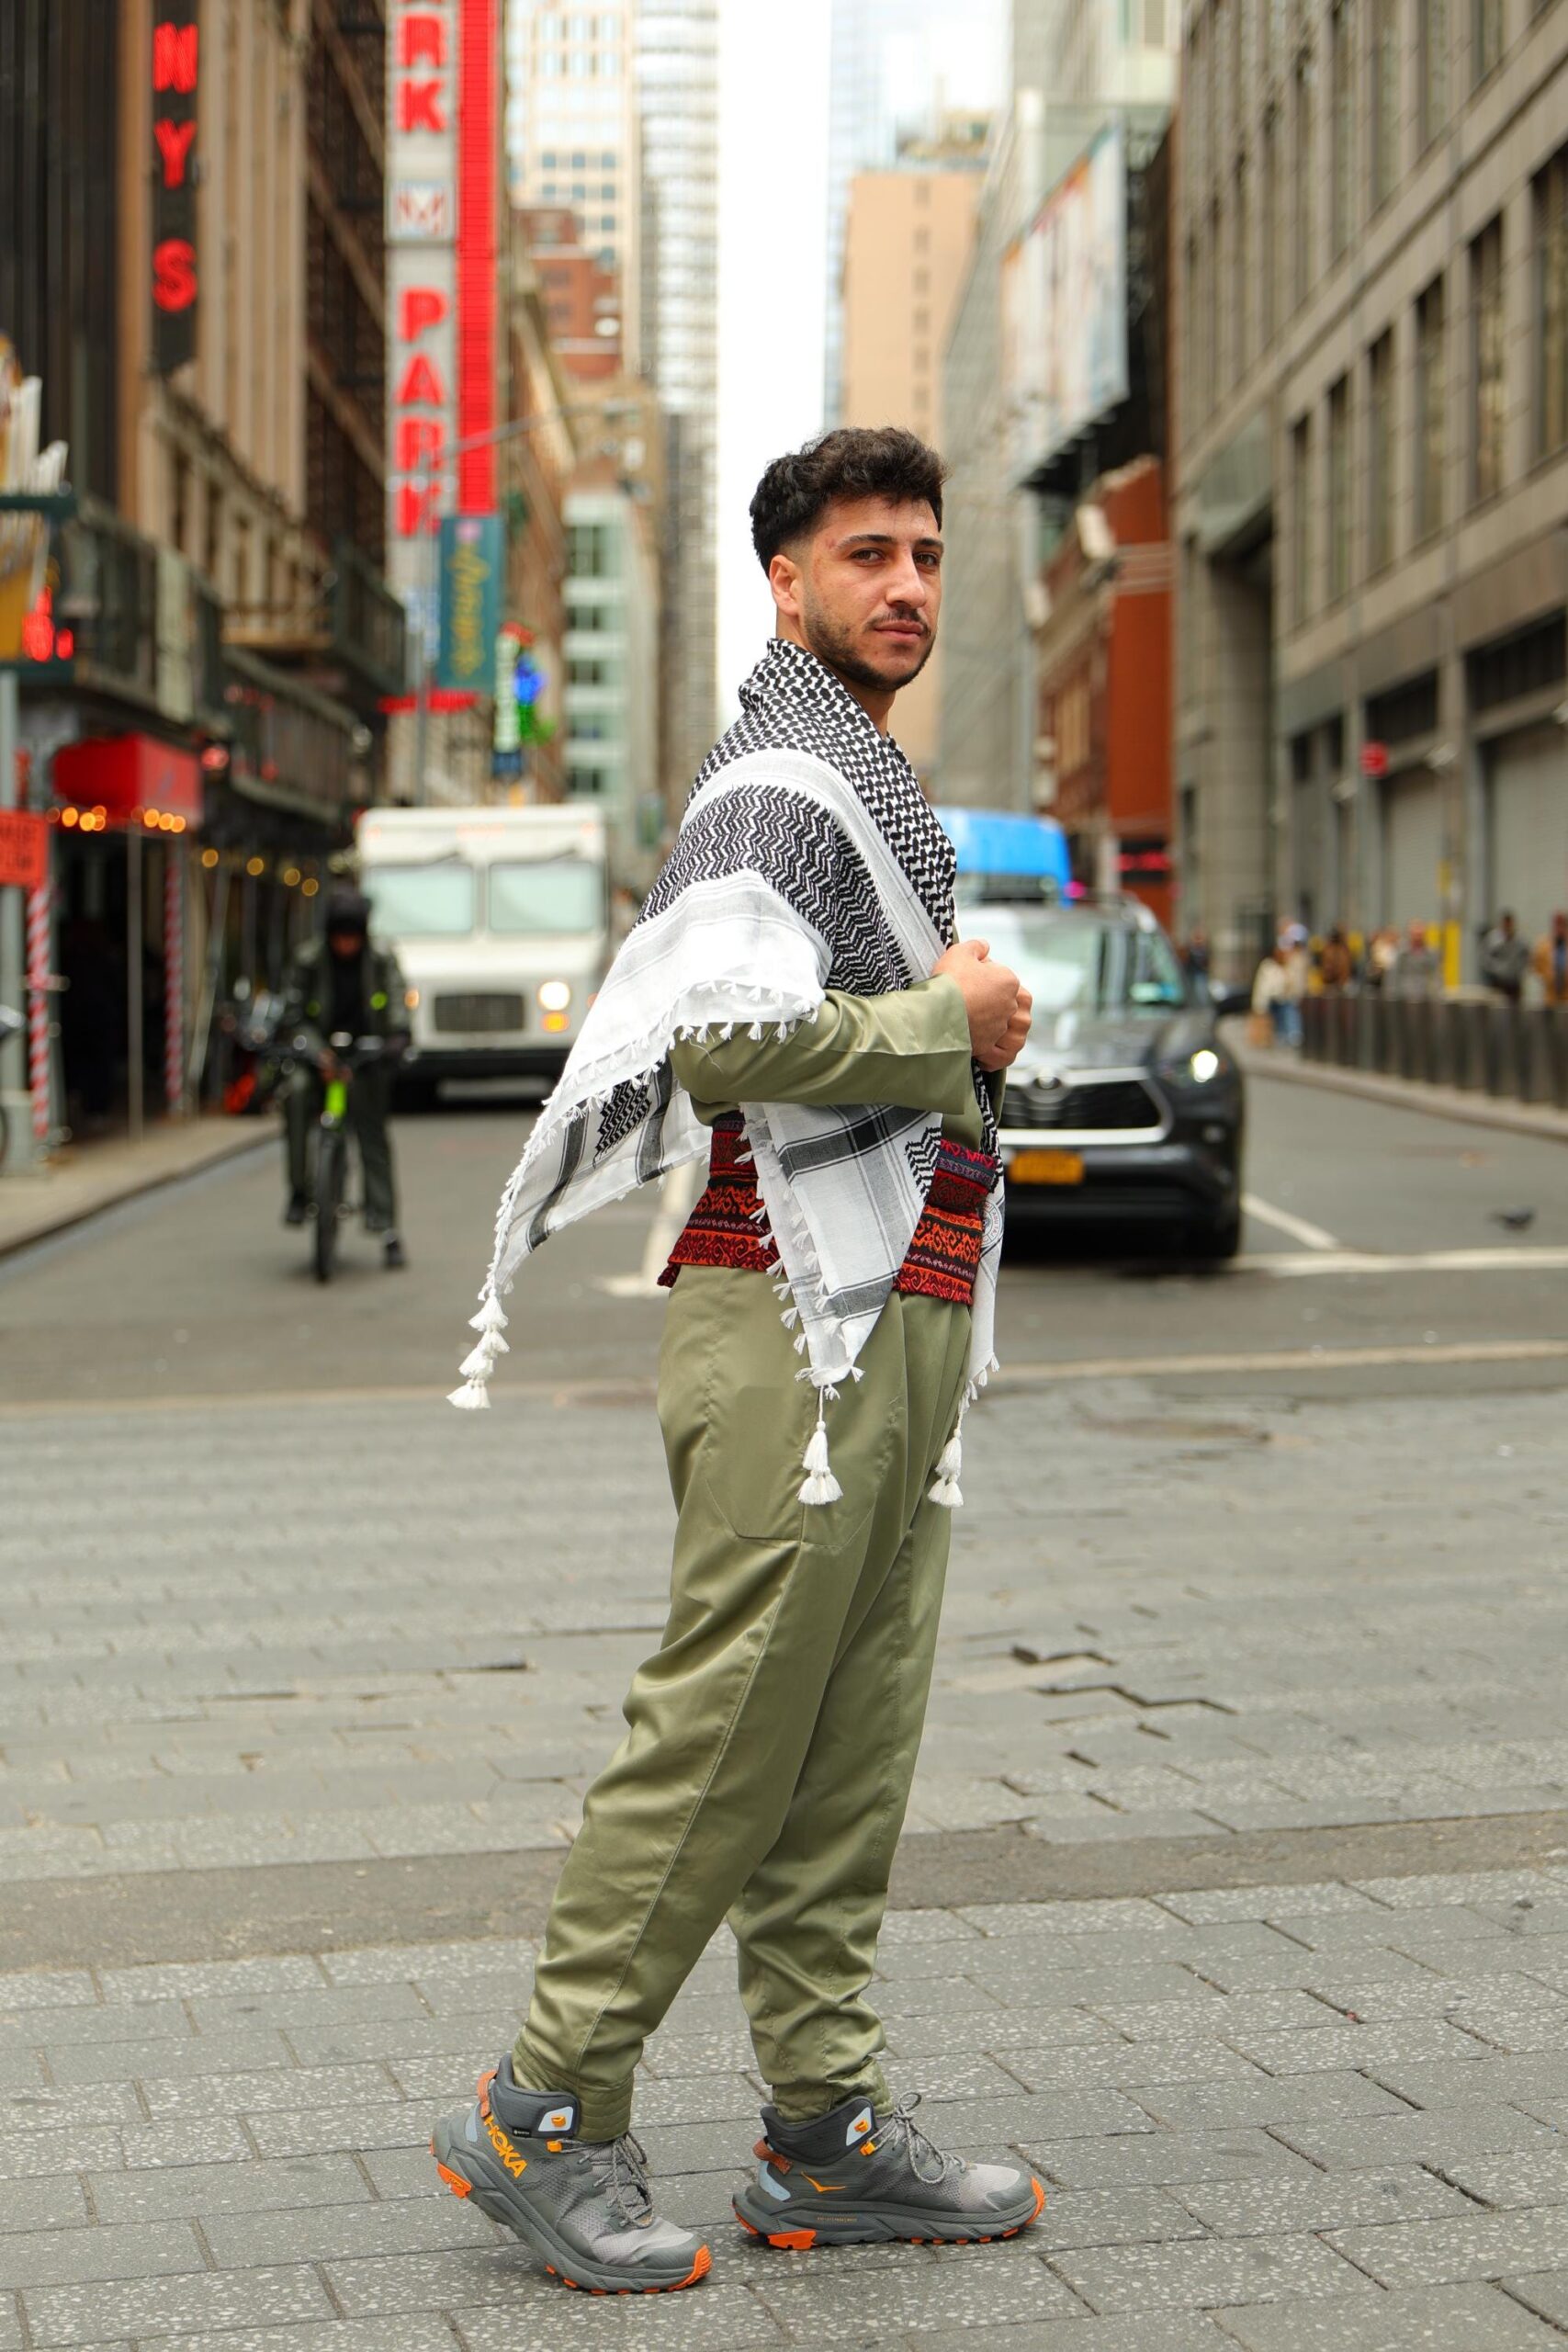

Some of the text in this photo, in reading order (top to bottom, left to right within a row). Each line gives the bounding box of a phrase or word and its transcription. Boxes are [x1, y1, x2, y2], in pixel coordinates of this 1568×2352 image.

[399, 0, 447, 131] RK
[152, 22, 198, 311] NYS
[397, 288, 446, 538] PARK
[483, 2115, 527, 2178] HOKA
